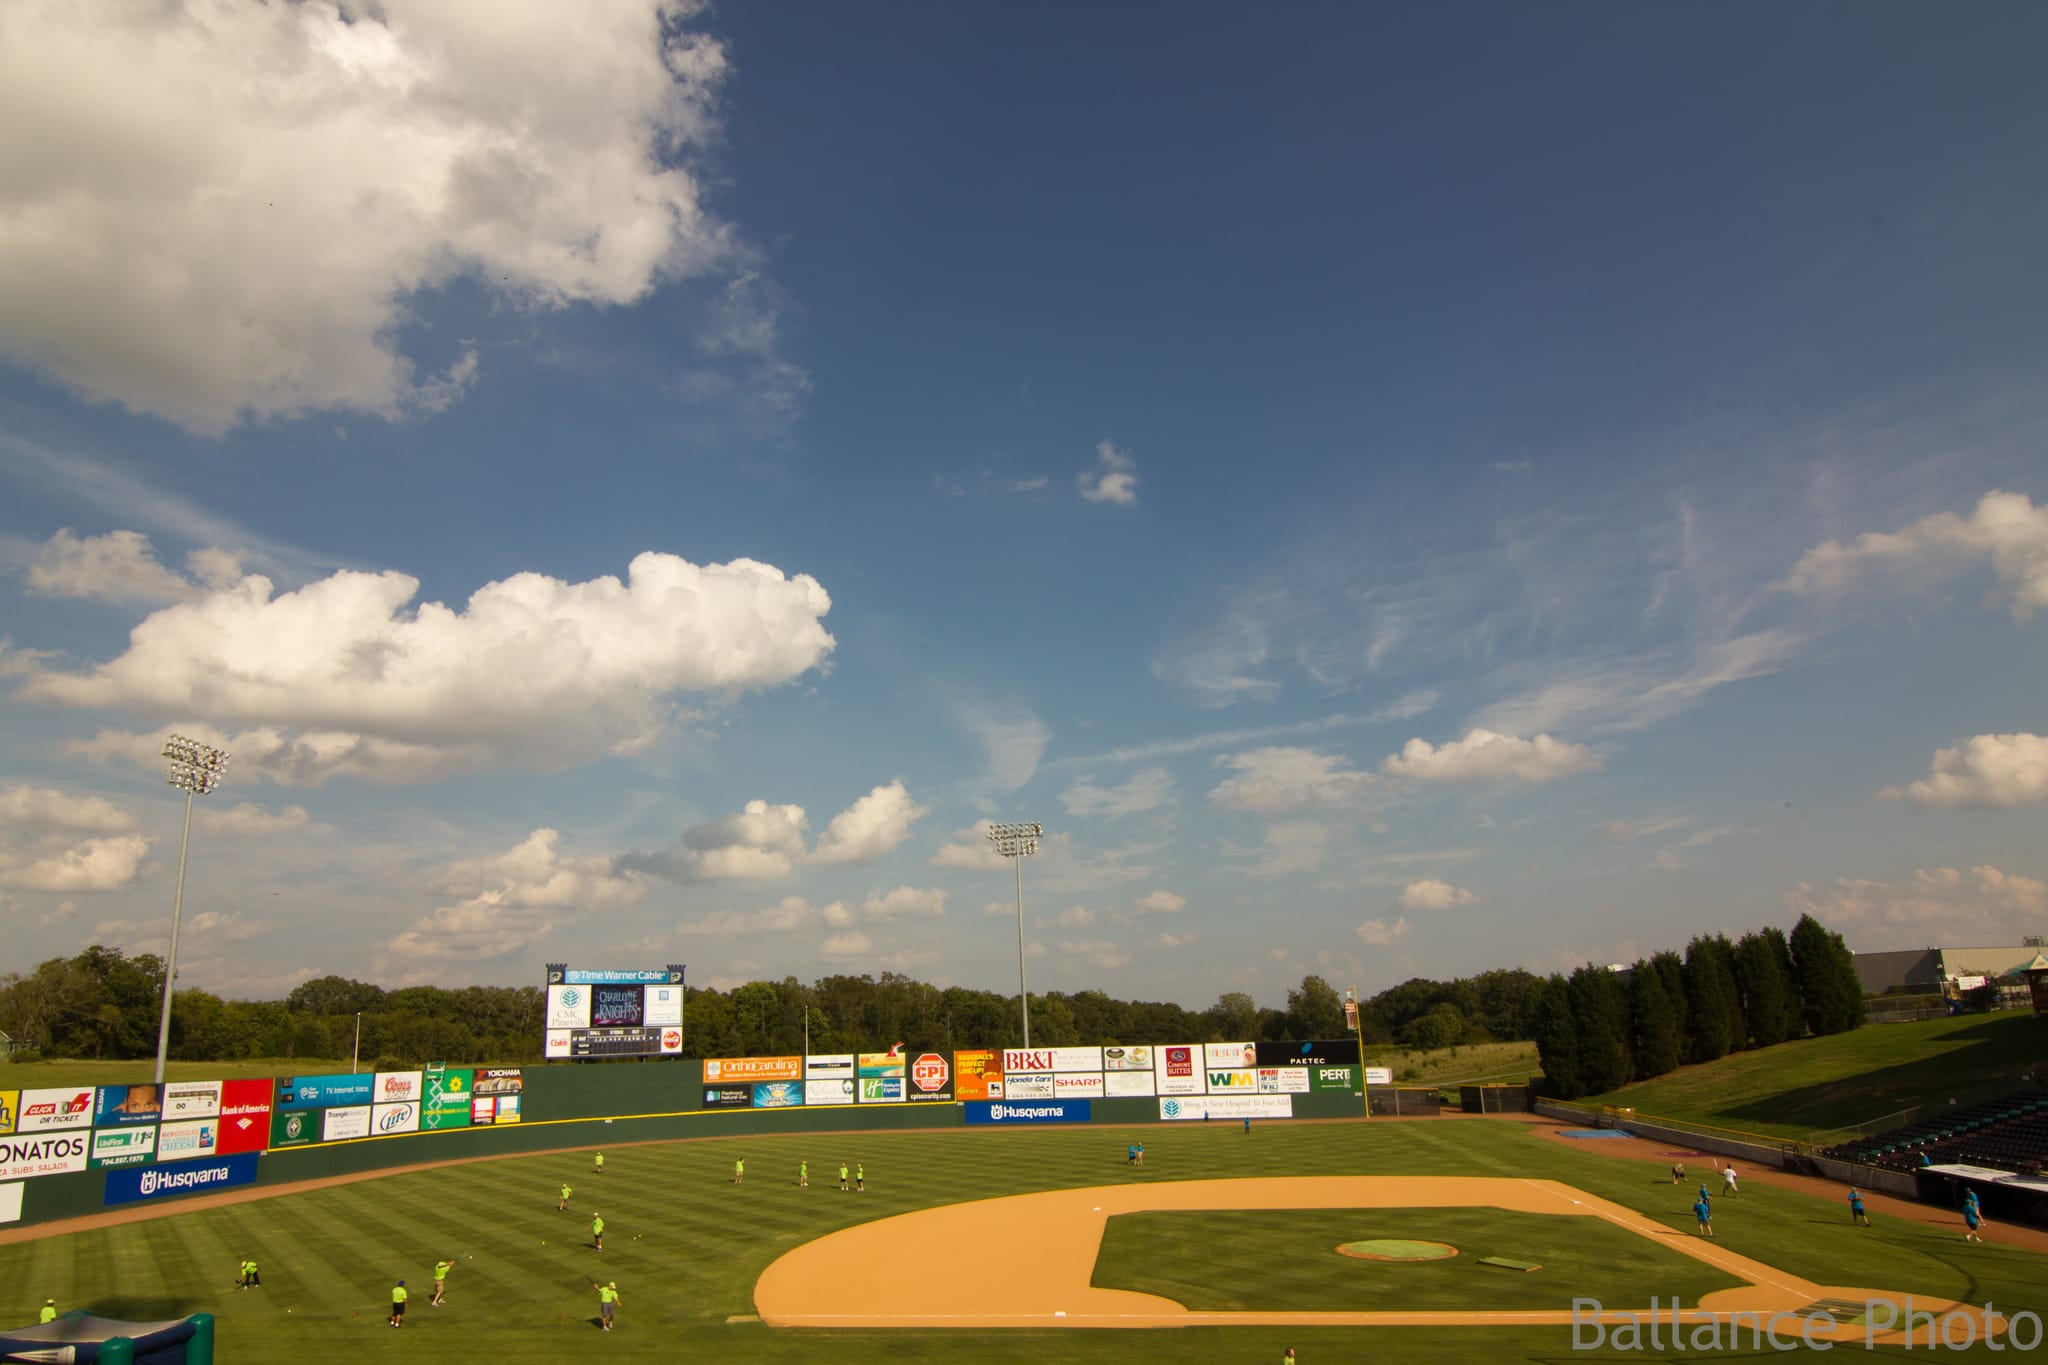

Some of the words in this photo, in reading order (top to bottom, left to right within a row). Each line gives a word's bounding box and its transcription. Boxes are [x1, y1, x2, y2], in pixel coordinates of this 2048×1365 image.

[580, 970, 603, 980] Time
[604, 970, 637, 980] Warner
[638, 970, 664, 980] Cable
[557, 1010, 577, 1018] CMC
[599, 1002, 638, 1019] KNIGHTS
[552, 1018, 586, 1027] Pineville
[723, 1058, 798, 1073] OrthoCarolina
[1005, 1051, 1057, 1070] BB&T
[488, 1068, 521, 1077] YOKOHAMA
[915, 1066, 946, 1078] CPI
[385, 1076, 411, 1091] Coors
[1006, 1076, 1033, 1085] Honda
[1056, 1079, 1101, 1087] SHARP
[910, 1092, 952, 1100] cpisecurity.com
[29, 1105, 53, 1114] CLICK
[71, 1103, 82, 1111] IT
[221, 1105, 238, 1115] Bank
[238, 1105, 246, 1114] of
[246, 1103, 270, 1113] America
[1003, 1106, 1063, 1118] Husqvarna
[52, 1115, 80, 1123] TICKET
[12, 1165, 34, 1175] SUBS
[38, 1162, 69, 1172] SALADS
[157, 1167, 229, 1188] Husqvarna
